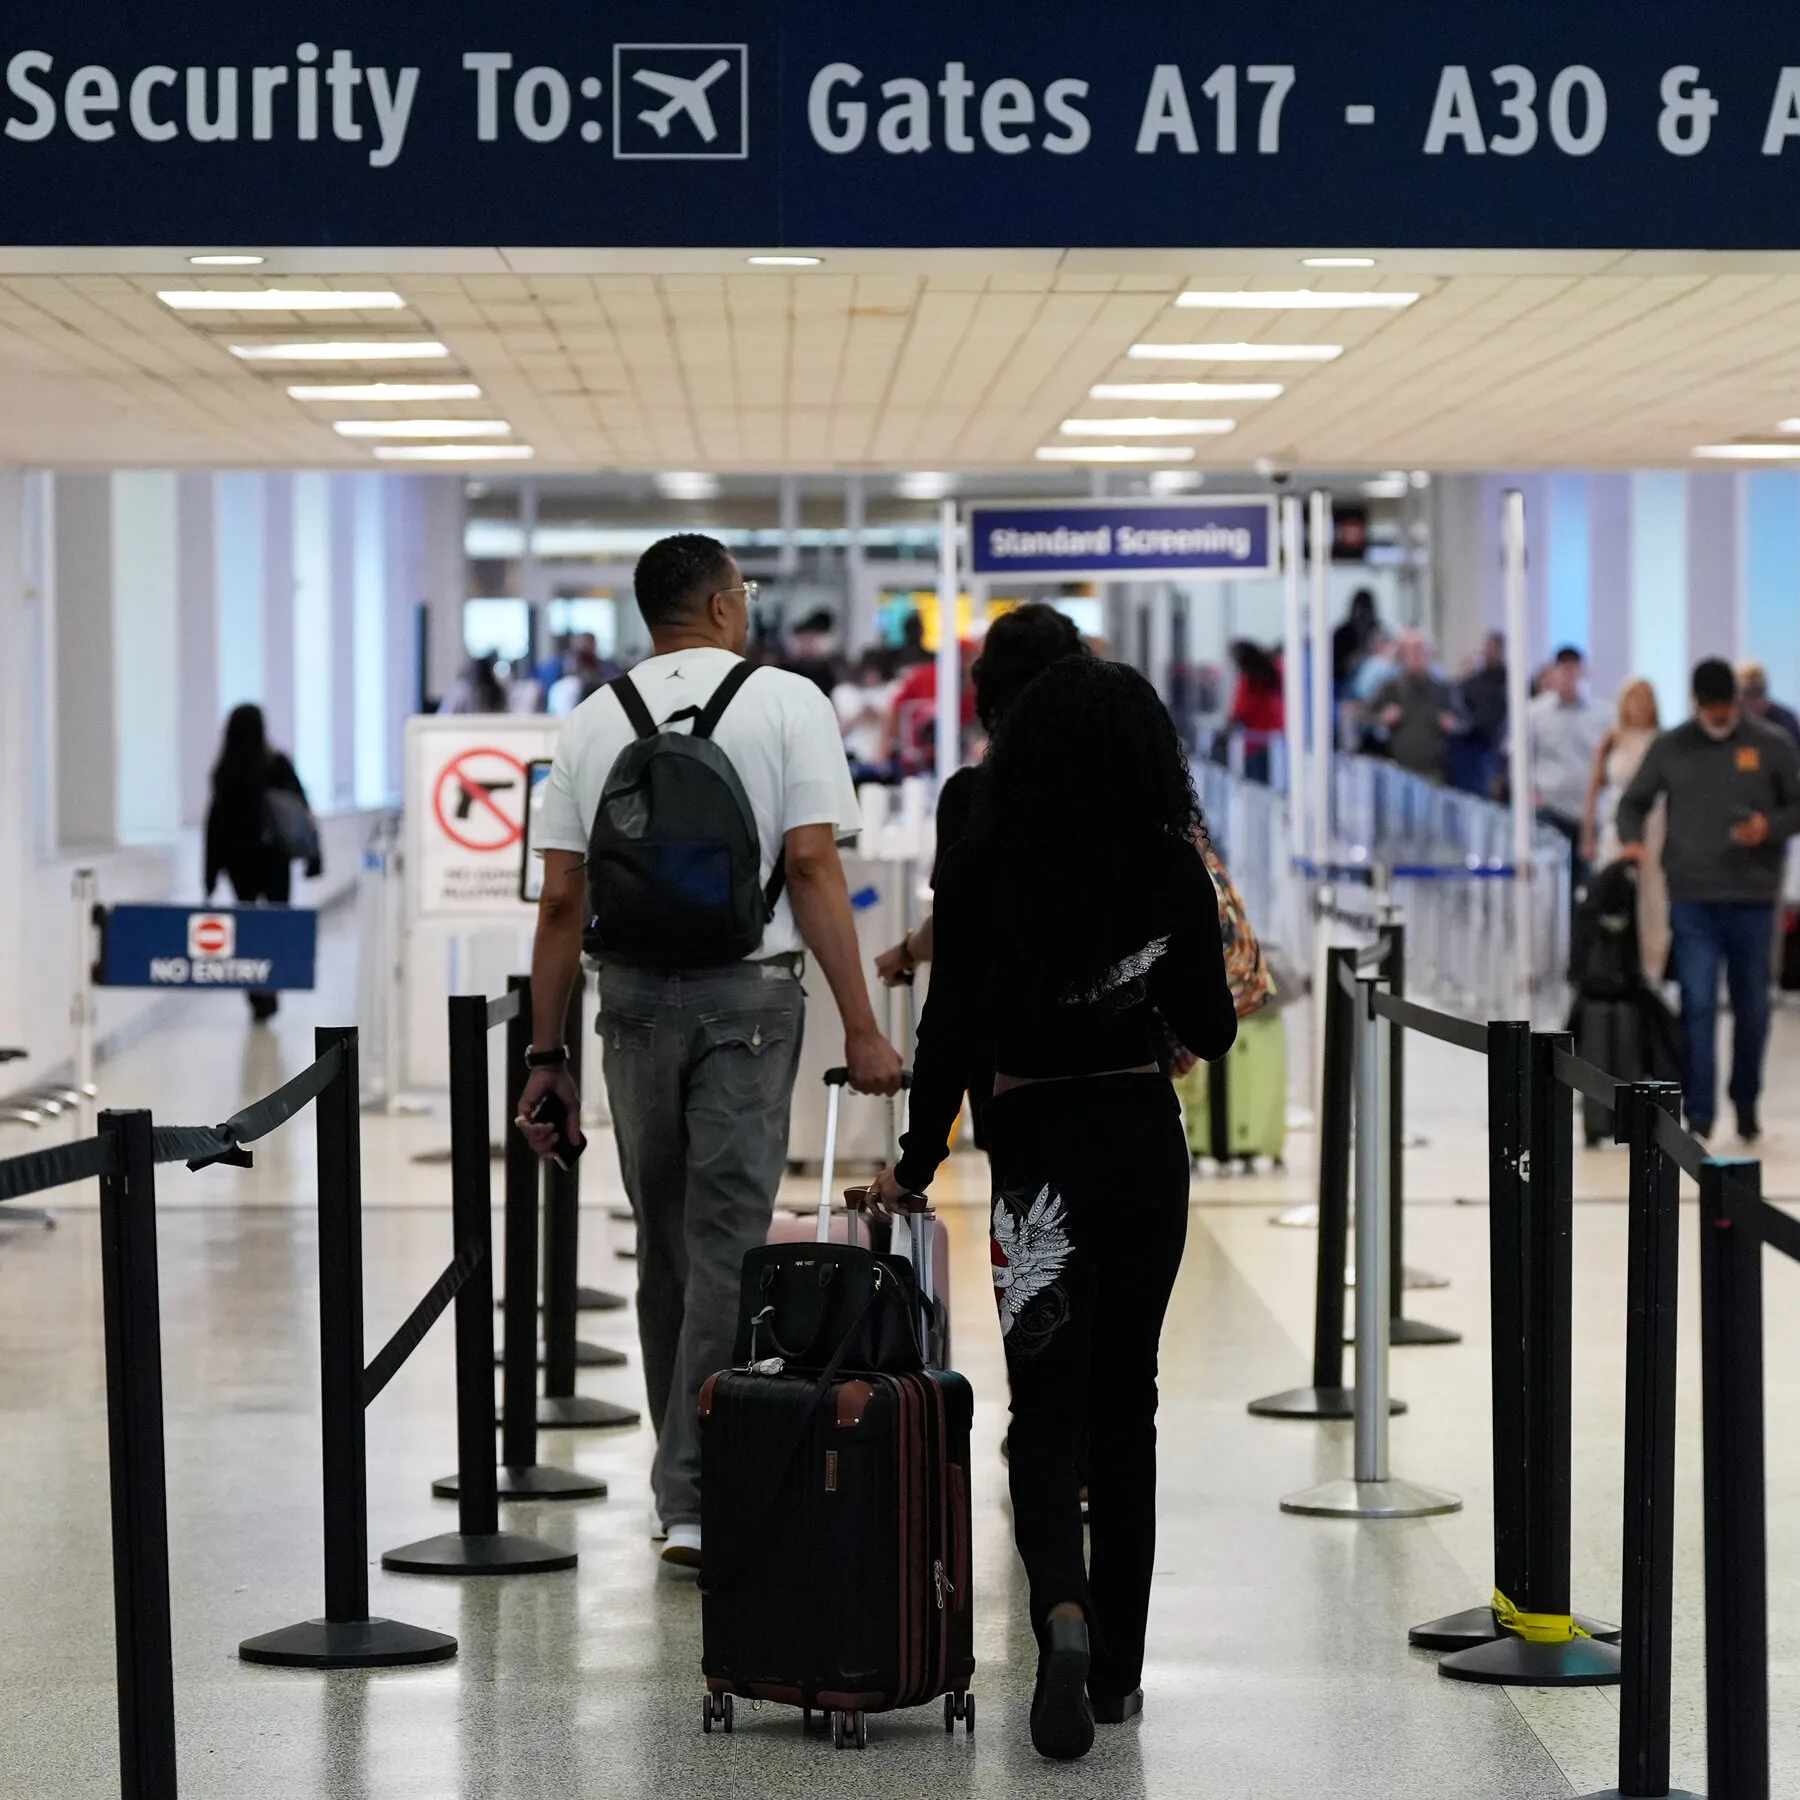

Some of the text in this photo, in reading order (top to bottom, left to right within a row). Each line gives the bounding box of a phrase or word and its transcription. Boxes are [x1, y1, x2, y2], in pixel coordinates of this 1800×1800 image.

[5, 43, 420, 167] Security
[463, 52, 604, 143] To:
[808, 60, 1091, 154] Gates
[1135, 64, 1297, 155] A17
[1345, 104, 1375, 124] -
[1423, 65, 1608, 156] A30
[1657, 65, 1719, 156] &
[990, 522, 1251, 559] Standard Screening
[151, 957, 272, 983] NO ENTRY
